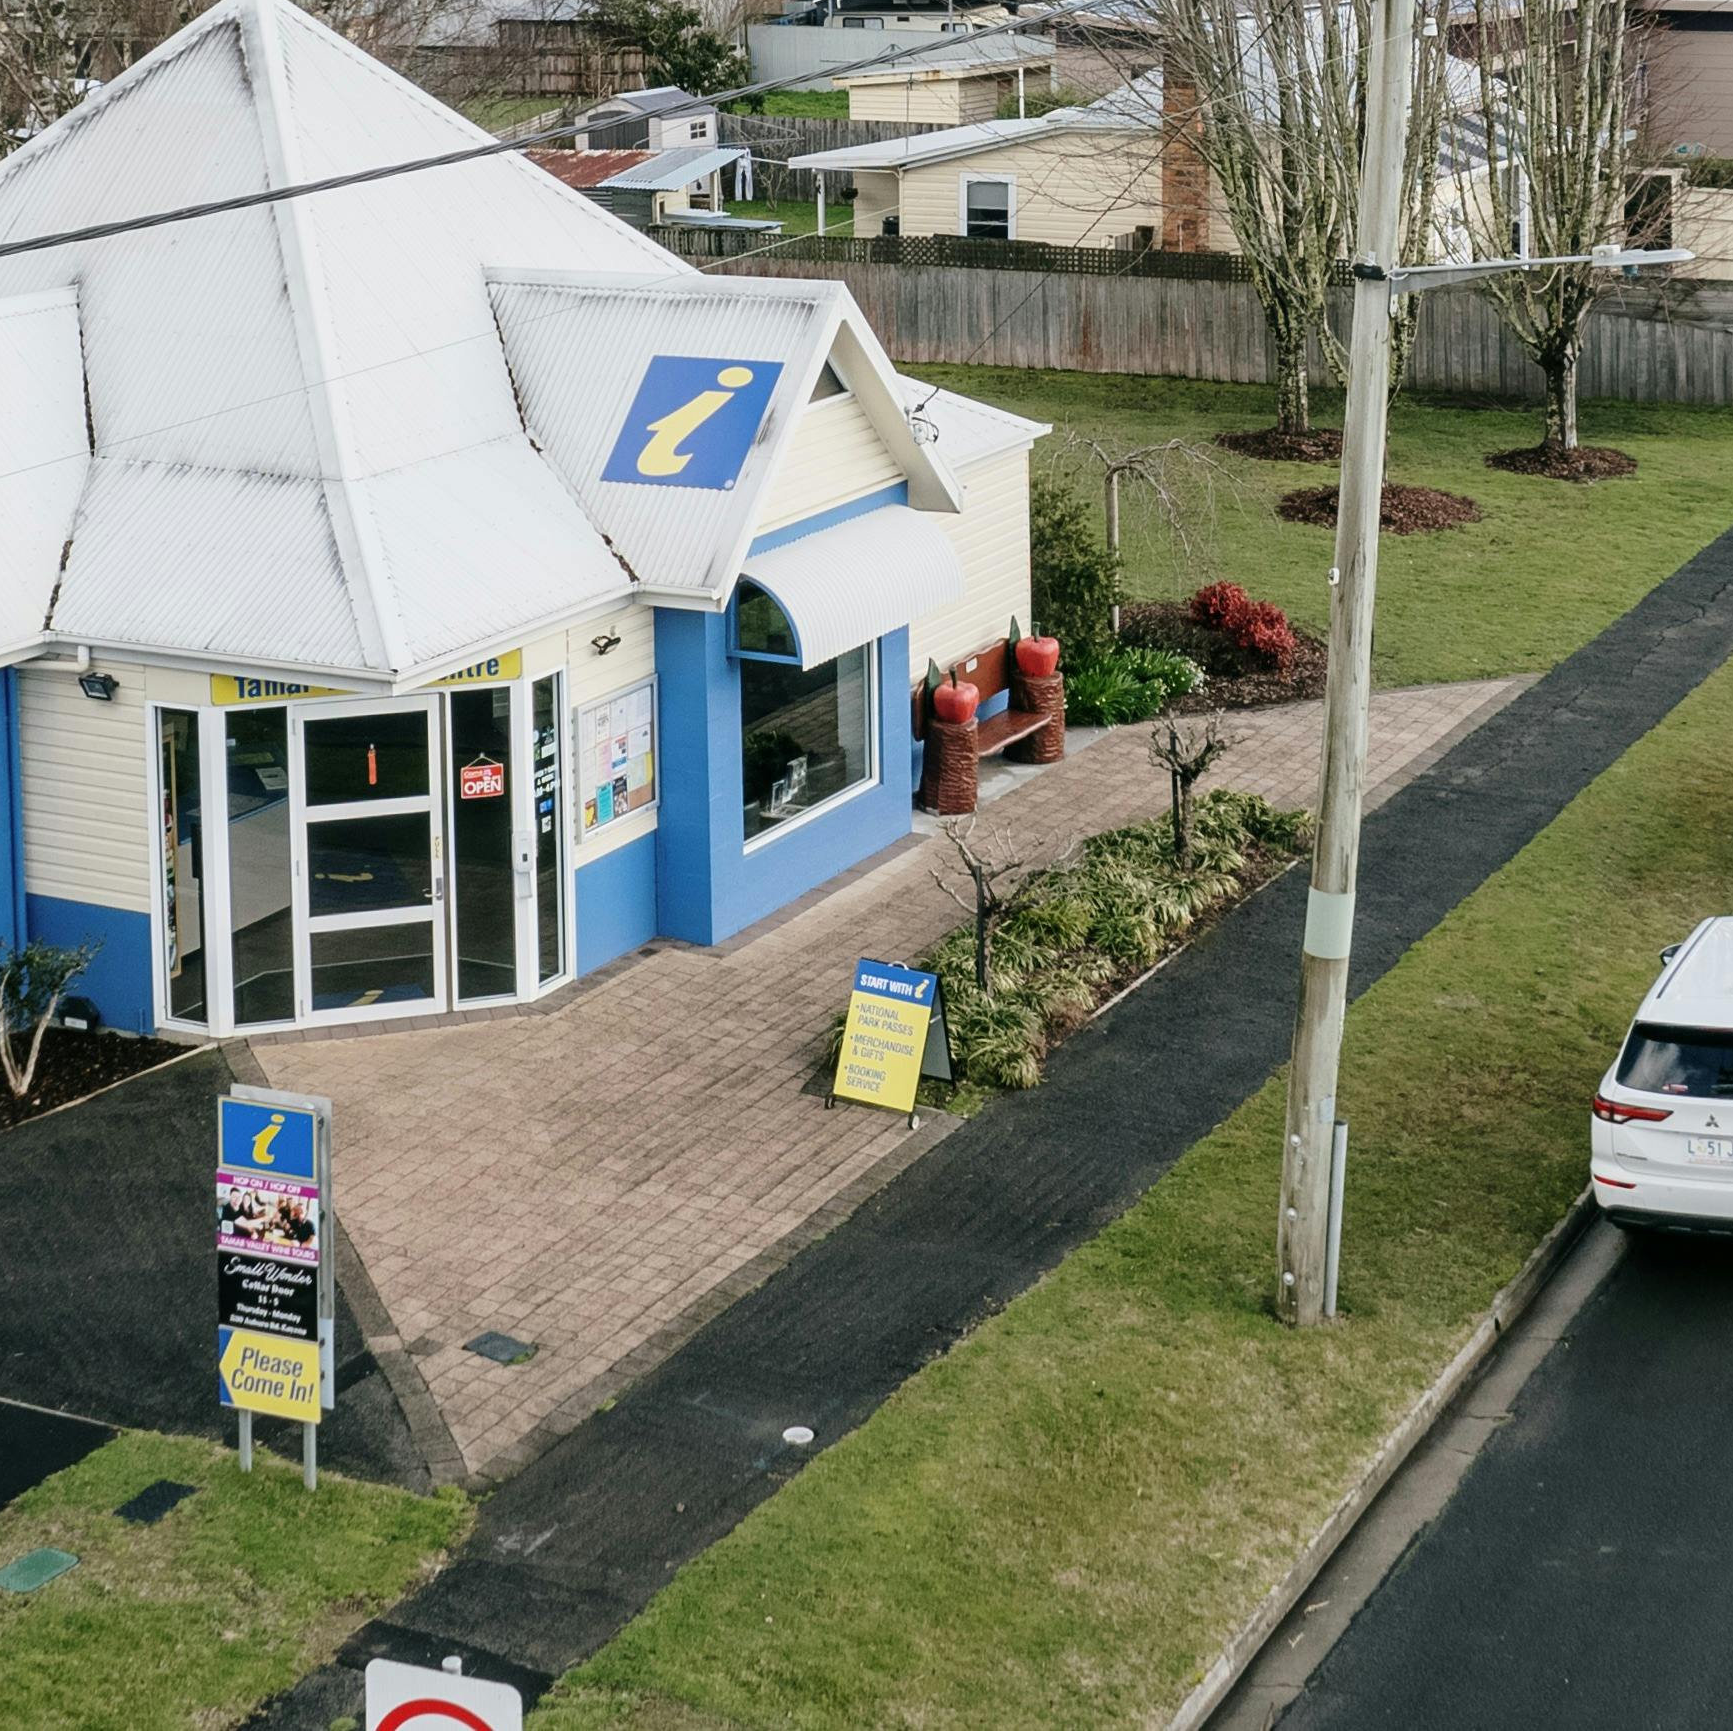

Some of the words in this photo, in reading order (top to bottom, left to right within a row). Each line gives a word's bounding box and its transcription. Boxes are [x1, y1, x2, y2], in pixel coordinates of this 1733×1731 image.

[464, 777, 502, 795] OPEN
[860, 974, 888, 990] START
[889, 980, 913, 996] WITH
[859, 1003, 899, 1020] NATIONAL
[858, 1014, 880, 1028] PARK
[882, 1020, 914, 1036] PASSES
[852, 1045, 858, 1056] &
[860, 1047, 884, 1061] GIFTS
[854, 1034, 914, 1056] MERCHANDISE
[848, 1064, 886, 1081] BOOKING
[846, 1075, 880, 1092] SERVICE
[1687, 1140, 1695, 1154] L
[1708, 1141, 1722, 1156] 51
[233, 1176, 249, 1185] HOP
[270, 1182, 286, 1191] HOP
[224, 1256, 266, 1277] Small
[265, 1262, 313, 1286] Wonder
[241, 1278, 270, 1291] Cellar
[271, 1284, 295, 1297] Door
[236, 1302, 268, 1318] Thursday
[272, 1310, 302, 1324] Monday
[241, 1346, 303, 1378] Please
[231, 1368, 285, 1398] Come
[289, 1379, 315, 1404] In!
